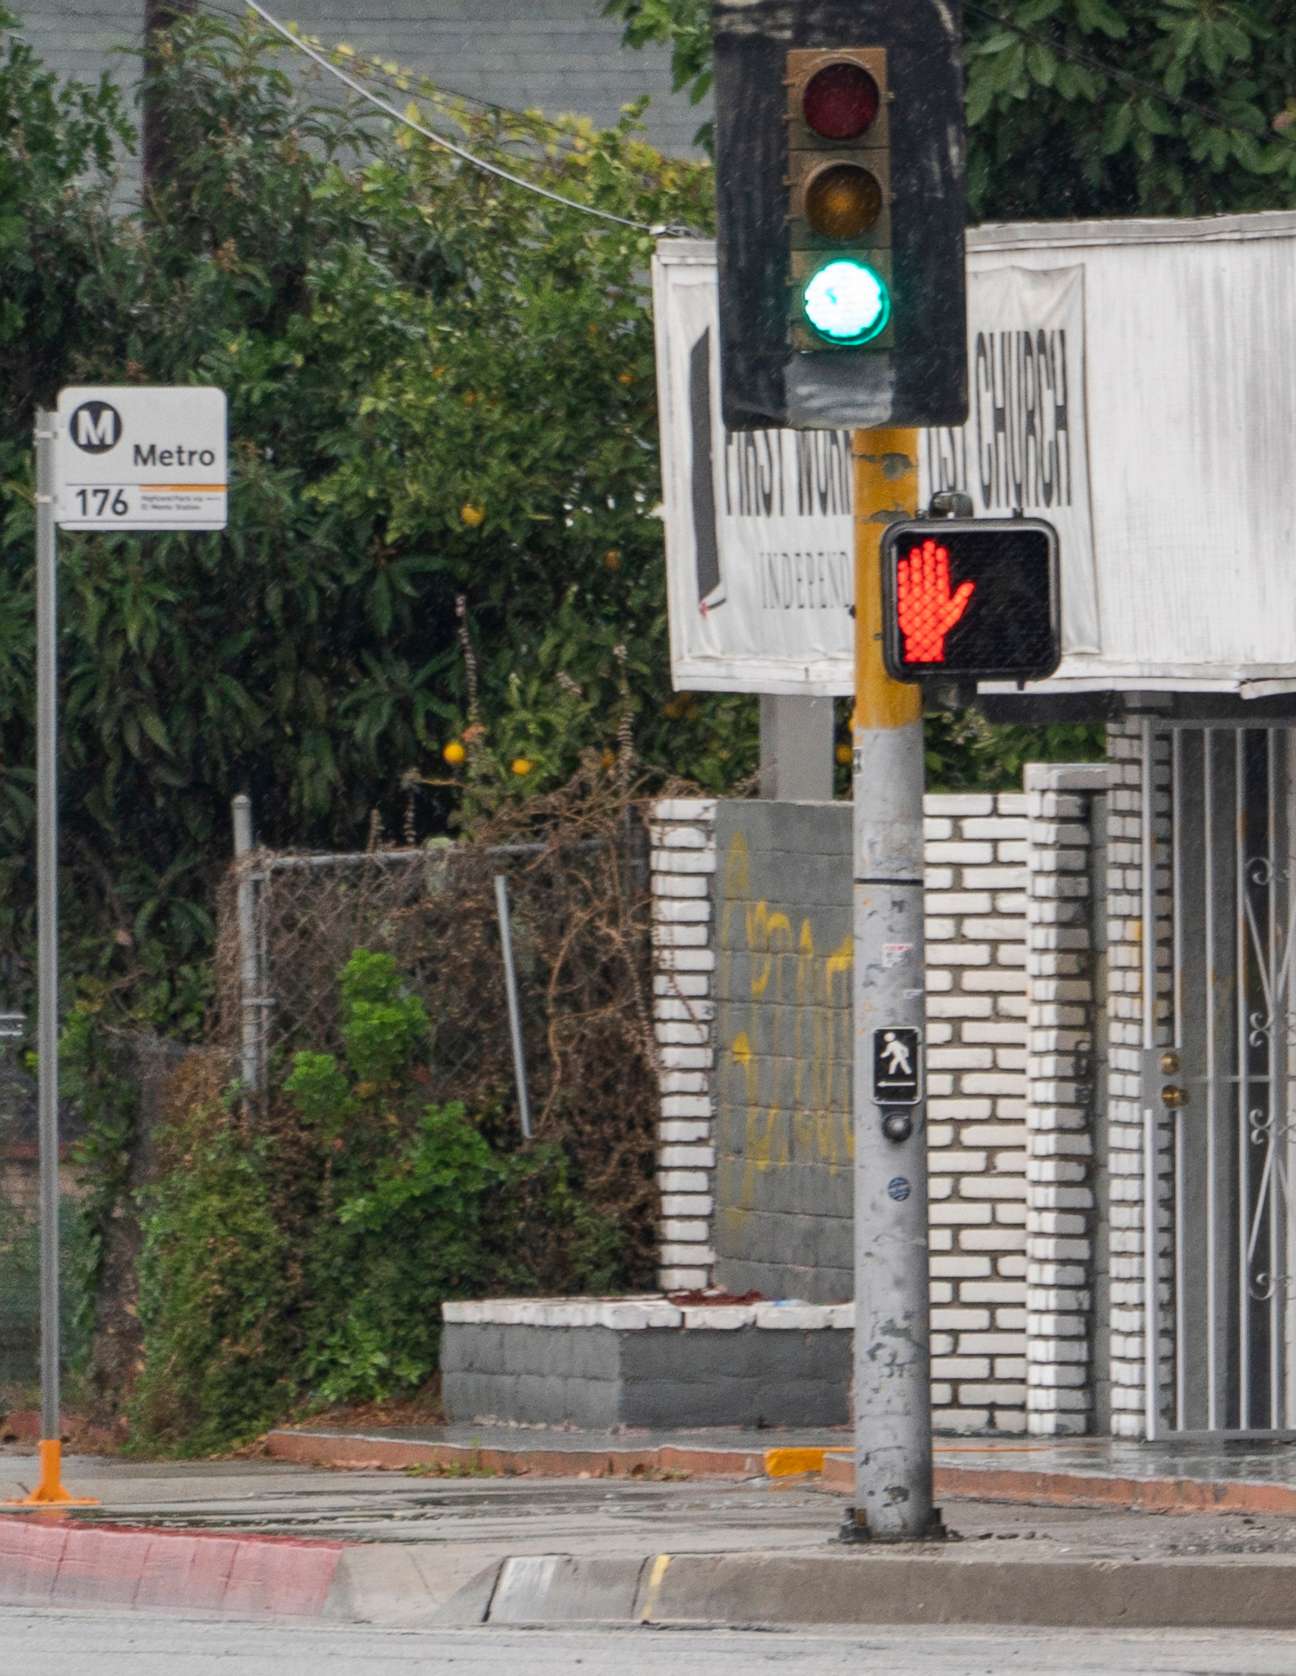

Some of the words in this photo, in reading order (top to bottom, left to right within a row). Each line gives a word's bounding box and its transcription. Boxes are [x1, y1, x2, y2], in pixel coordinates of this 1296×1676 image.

[75, 408, 117, 448] M
[975, 330, 1072, 510] CHURCH
[133, 444, 215, 467] Metro
[75, 488, 129, 517] 176
[760, 551, 855, 610] INDEPEND
